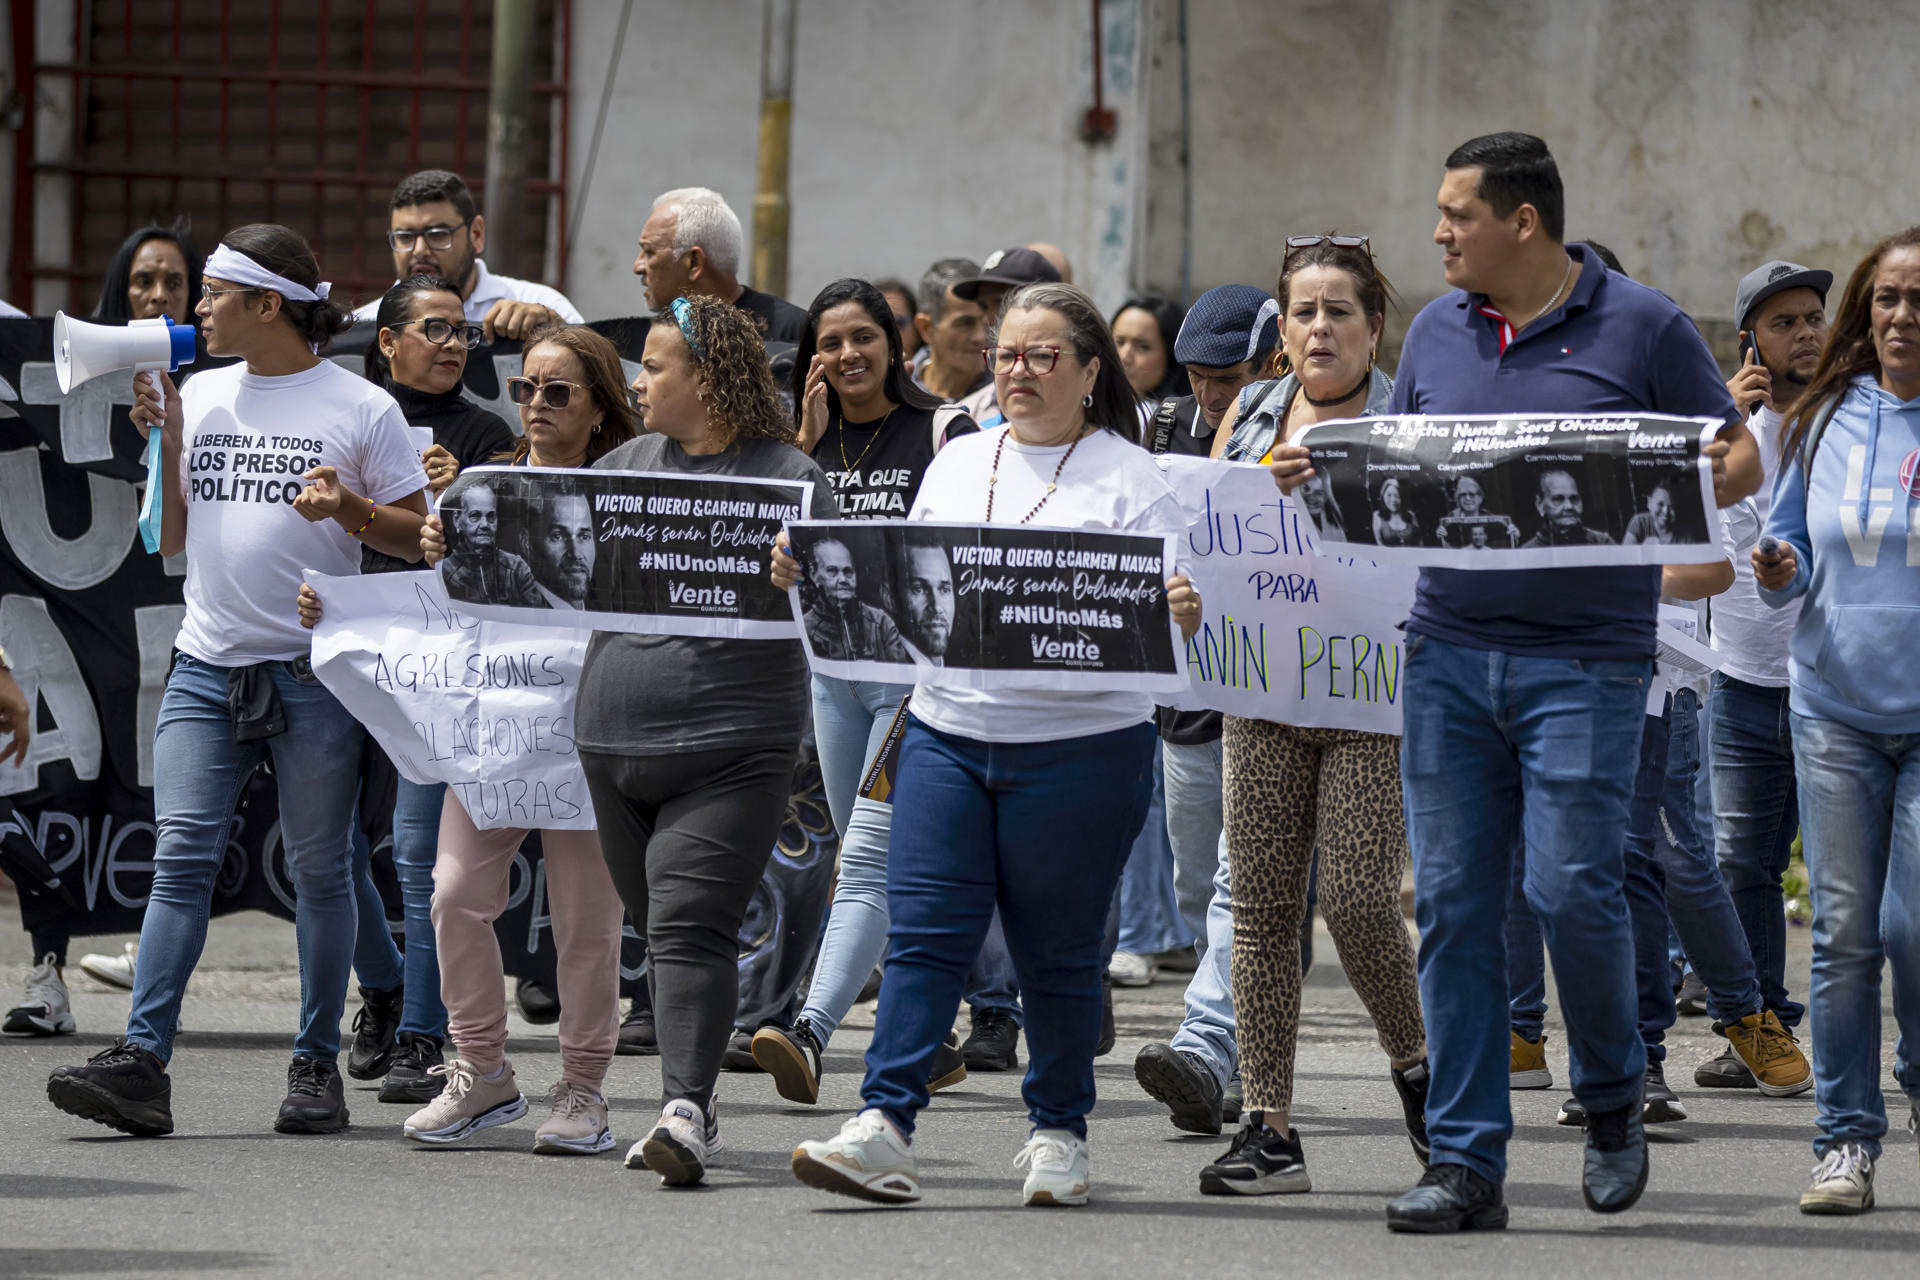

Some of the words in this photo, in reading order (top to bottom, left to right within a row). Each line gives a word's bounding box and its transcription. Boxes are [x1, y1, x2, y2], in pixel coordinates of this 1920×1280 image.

[1370, 422, 1395, 436] Su
[1558, 419, 1640, 432] Olvidada
[1627, 431, 1687, 449] Vente
[193, 434, 253, 448] LIBEREN
[256, 435, 266, 449] A
[271, 436, 324, 454] TODOS
[190, 451, 226, 473] LOS
[232, 453, 321, 475] PRESOS
[192, 473, 308, 506] POLÍTICO
[825, 469, 863, 488] STA
[868, 469, 912, 487] QUE
[595, 494, 643, 513] VICTOR
[646, 496, 691, 516] QUERO
[758, 502, 800, 521] NAVAS
[599, 515, 658, 543] Jamás
[661, 521, 706, 544] serán
[639, 552, 761, 575] #NiUnoMás
[952, 546, 1002, 566] VICTOR
[1006, 547, 1053, 568] QUERO
[1119, 554, 1162, 574] NAVAS
[667, 579, 737, 606] Vente
[958, 569, 1018, 596] Jamás
[1022, 574, 1070, 596] serán
[1248, 570, 1319, 603] PARA
[1000, 605, 1124, 629] #NiUnoMás
[1031, 633, 1100, 661] Vente
[374, 652, 565, 692] AGRESIONES
[1298, 625, 1399, 704] PERN
[413, 716, 577, 761] LACIONES
[453, 778, 581, 821] TURAS
